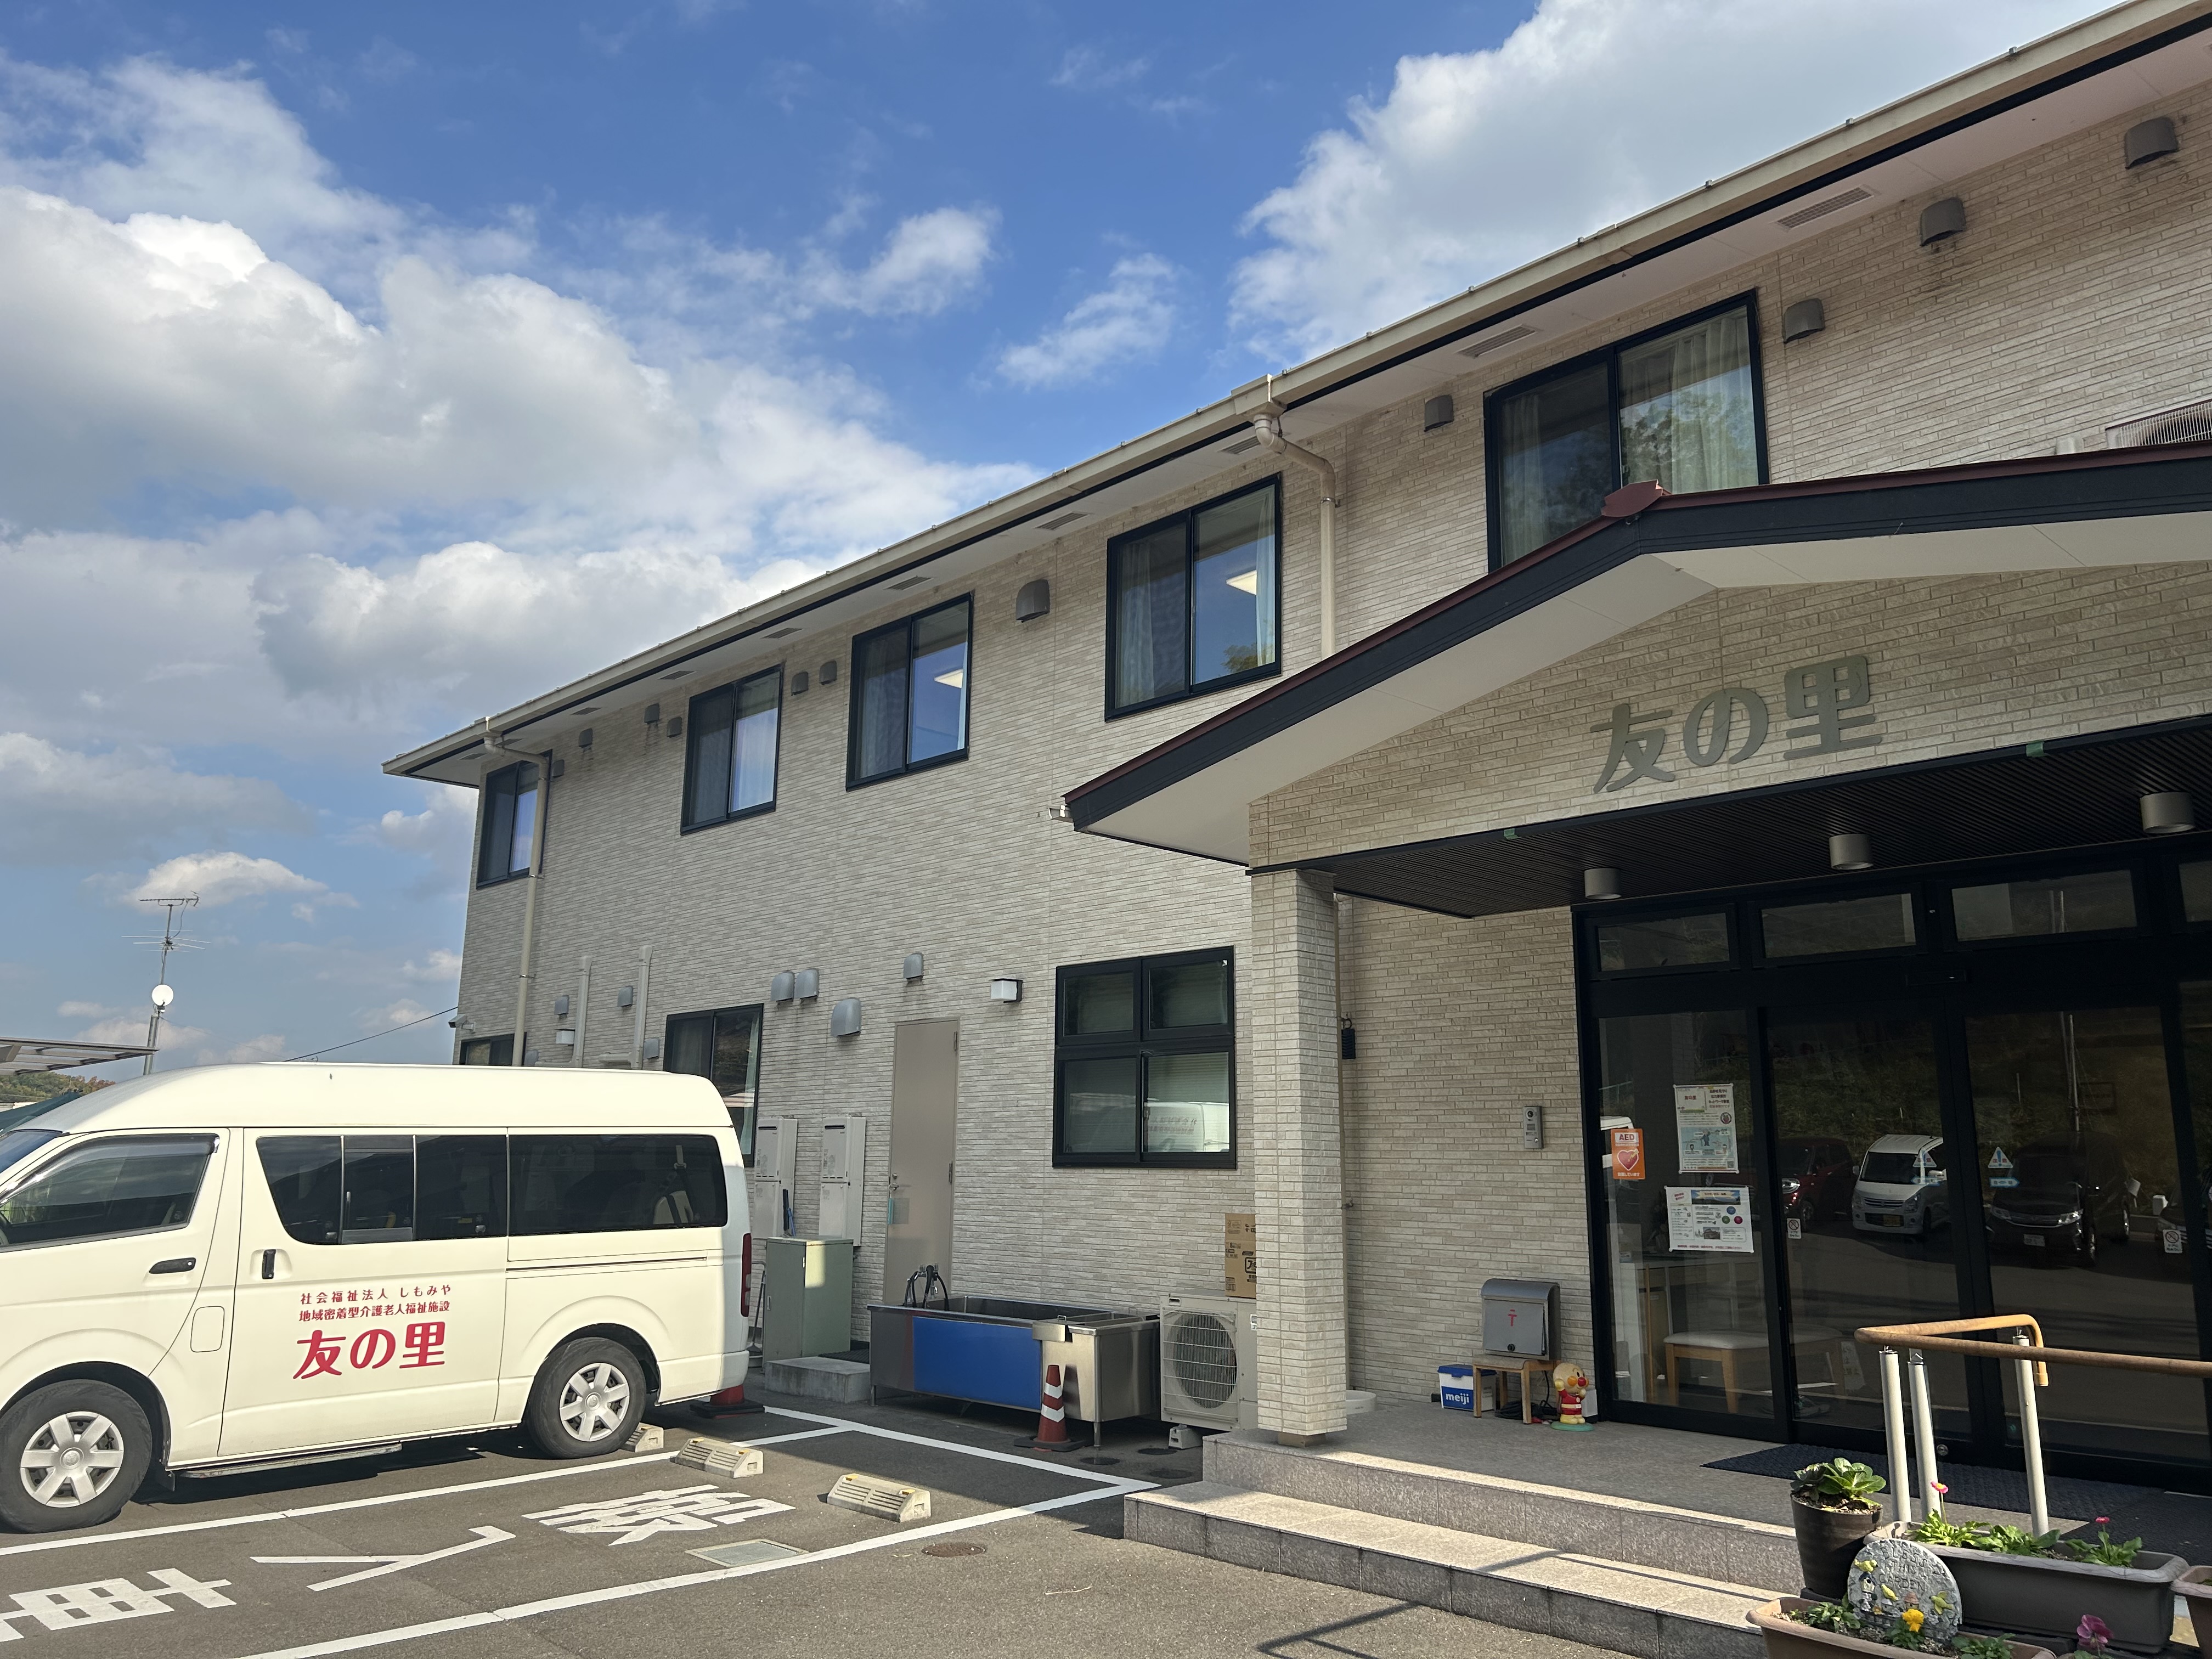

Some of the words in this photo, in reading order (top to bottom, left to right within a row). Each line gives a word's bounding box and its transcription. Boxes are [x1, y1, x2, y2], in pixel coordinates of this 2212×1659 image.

[1589, 654, 1882, 793] 友の里
[300, 1288, 388, 1305] 社会福祉法人
[400, 1284, 451, 1298] しもみや
[299, 1300, 450, 1322] 地域密着型介護老人福祉施設
[293, 1321, 446, 1380] 友の里
[1446, 1392, 1470, 1405] meiji
[1880, 1547, 1928, 1567] BLESS
[1891, 1561, 1916, 1575] THIS
[1878, 1573, 1926, 1592] GARDEN
